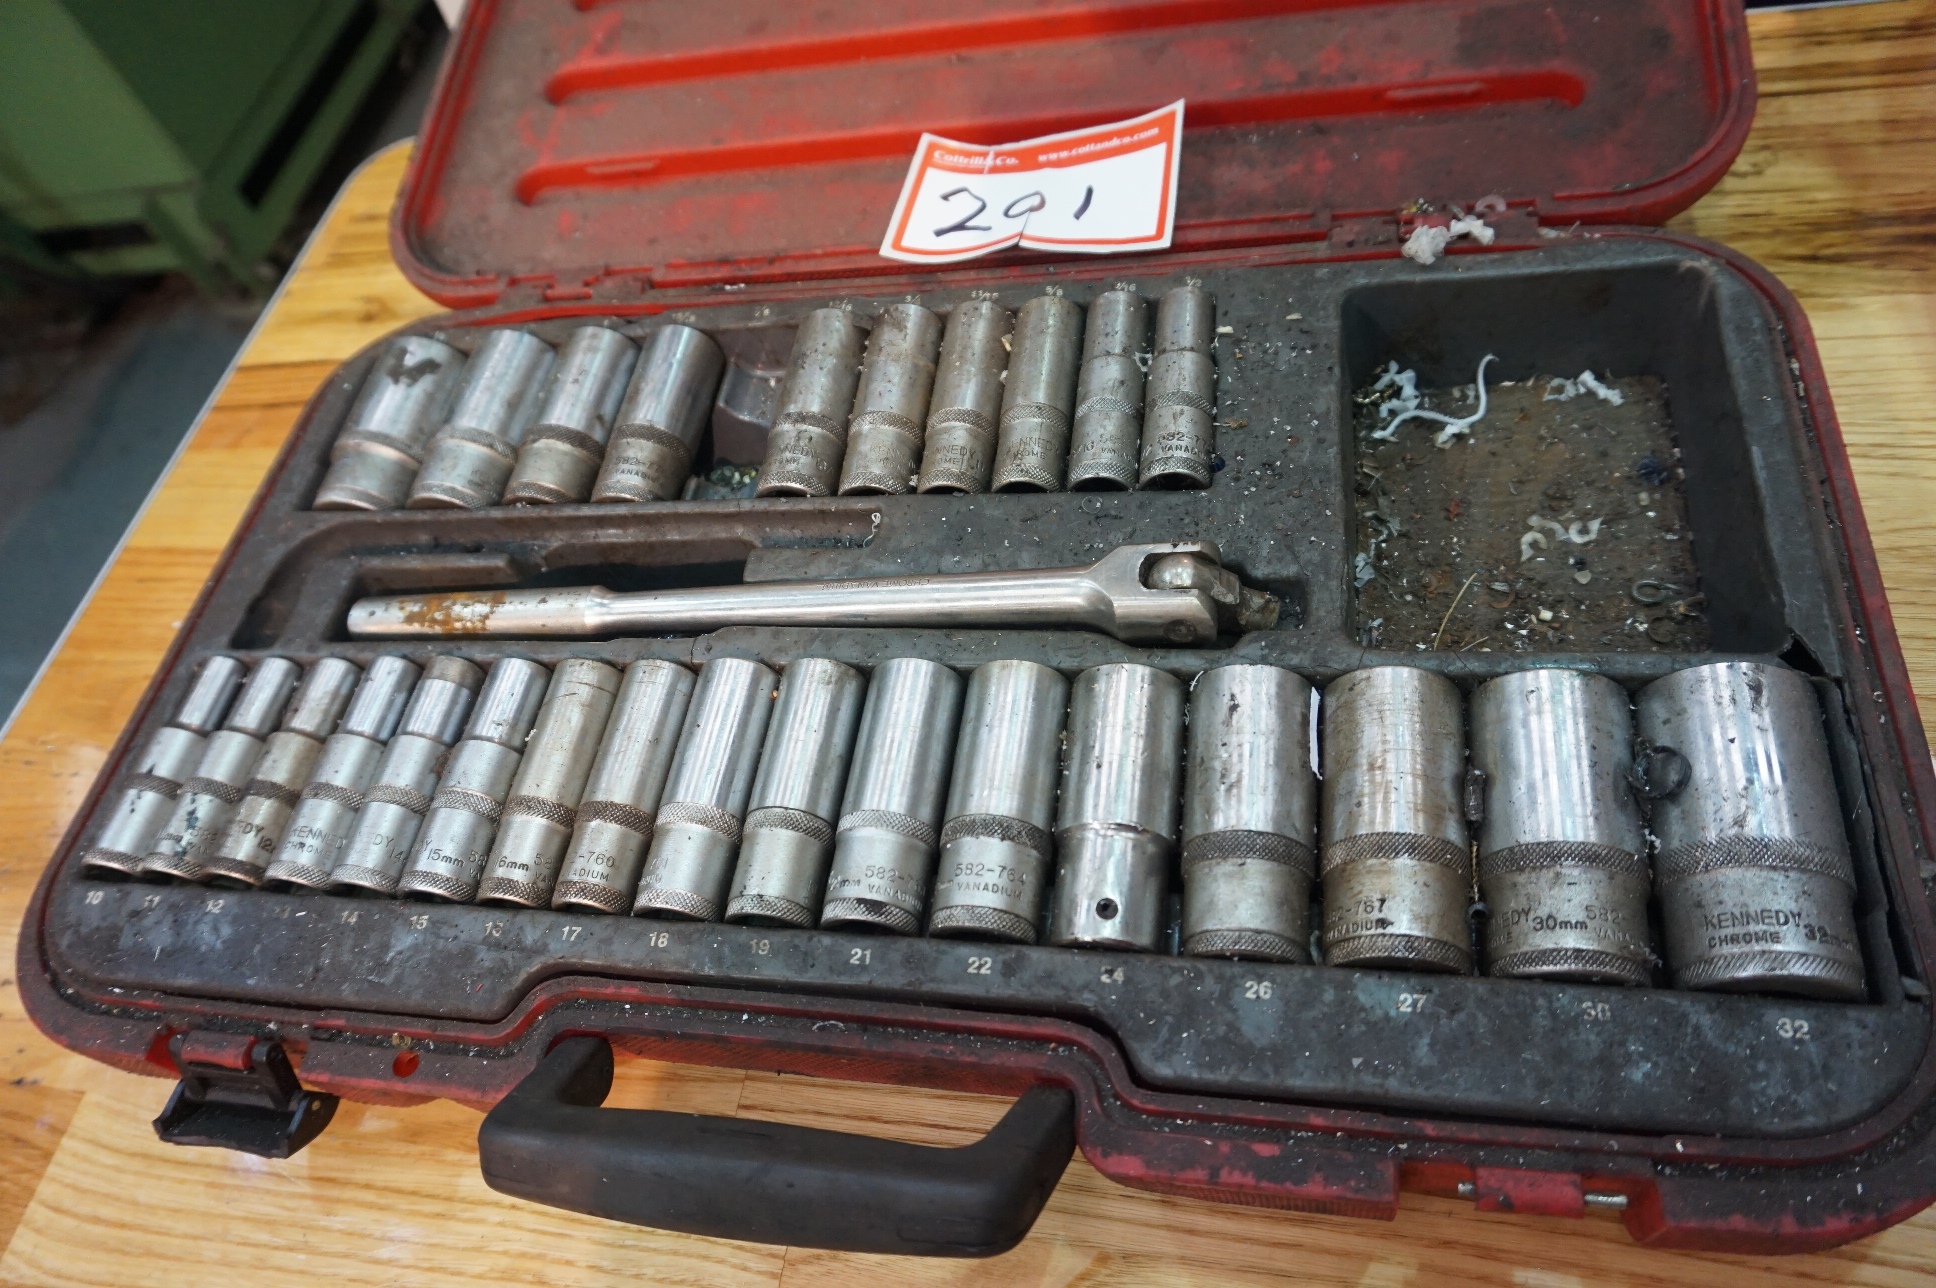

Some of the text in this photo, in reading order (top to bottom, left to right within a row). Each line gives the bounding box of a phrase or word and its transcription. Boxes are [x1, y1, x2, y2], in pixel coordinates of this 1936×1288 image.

[1037, 127, 1159, 163] www.cottandco.com
[933, 184, 1093, 237] 201
[427, 848, 465, 868] 15mm
[954, 863, 1026, 886] 582-764
[85, 890, 104, 905] 10
[957, 881, 1023, 900] VANADIUM
[206, 899, 225, 914] 12
[409, 915, 430, 930] 15
[1532, 915, 1588, 932] 30mm
[1702, 909, 1802, 932] KENNEDY
[561, 925, 583, 942] 17
[649, 932, 670, 948] 18
[1707, 930, 1783, 948] CHROME
[751, 939, 771, 955] 19
[850, 948, 872, 965] 21
[966, 956, 993, 975] 22
[1244, 980, 1273, 1000] 26
[1397, 992, 1427, 1013] 27
[1776, 1017, 1811, 1040] 32
